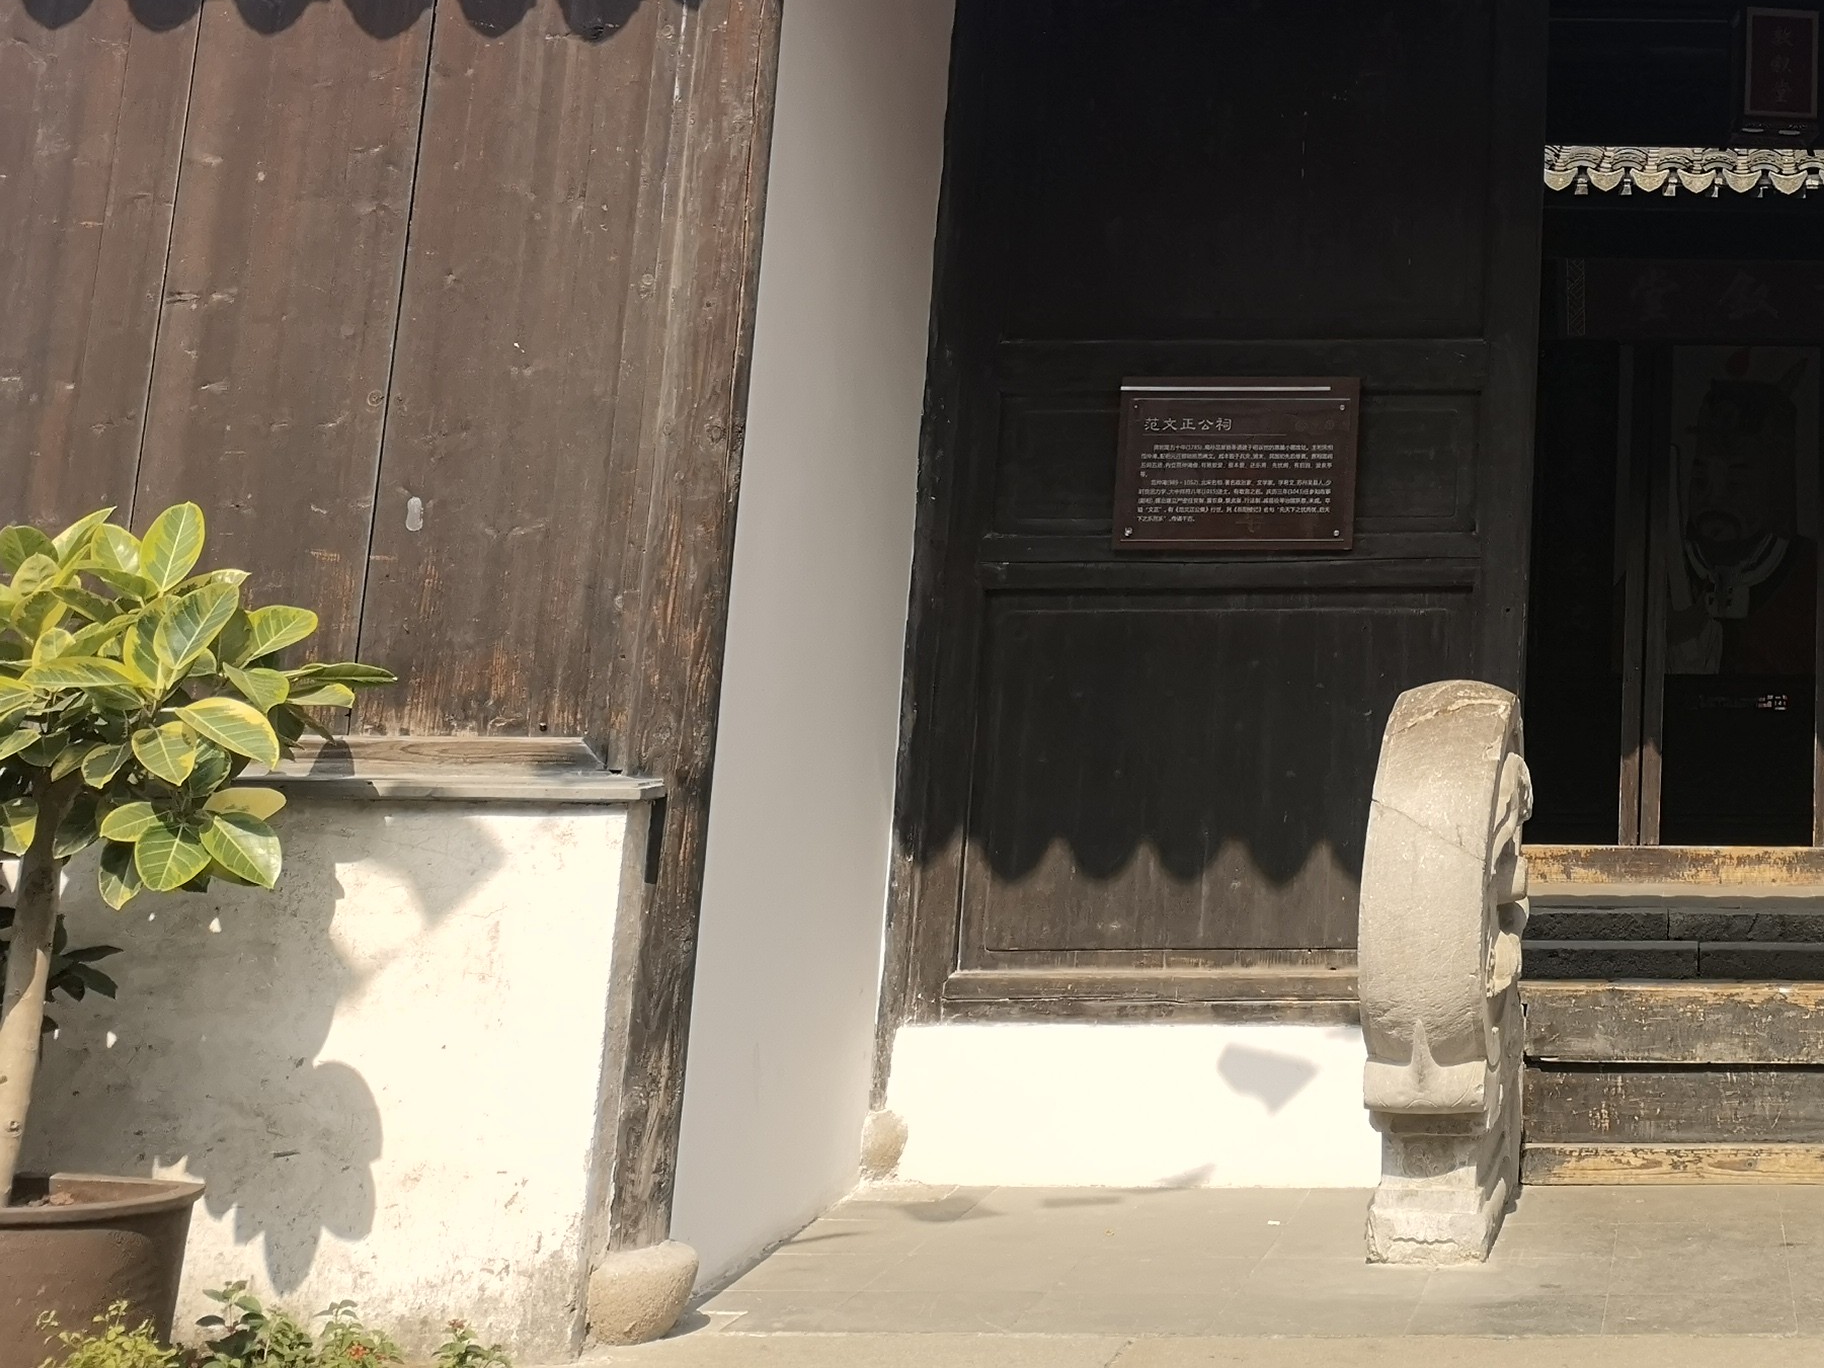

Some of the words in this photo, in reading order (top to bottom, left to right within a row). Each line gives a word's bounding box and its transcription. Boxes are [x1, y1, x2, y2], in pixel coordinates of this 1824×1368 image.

[1143, 417, 1233, 432] 范文正公祠
